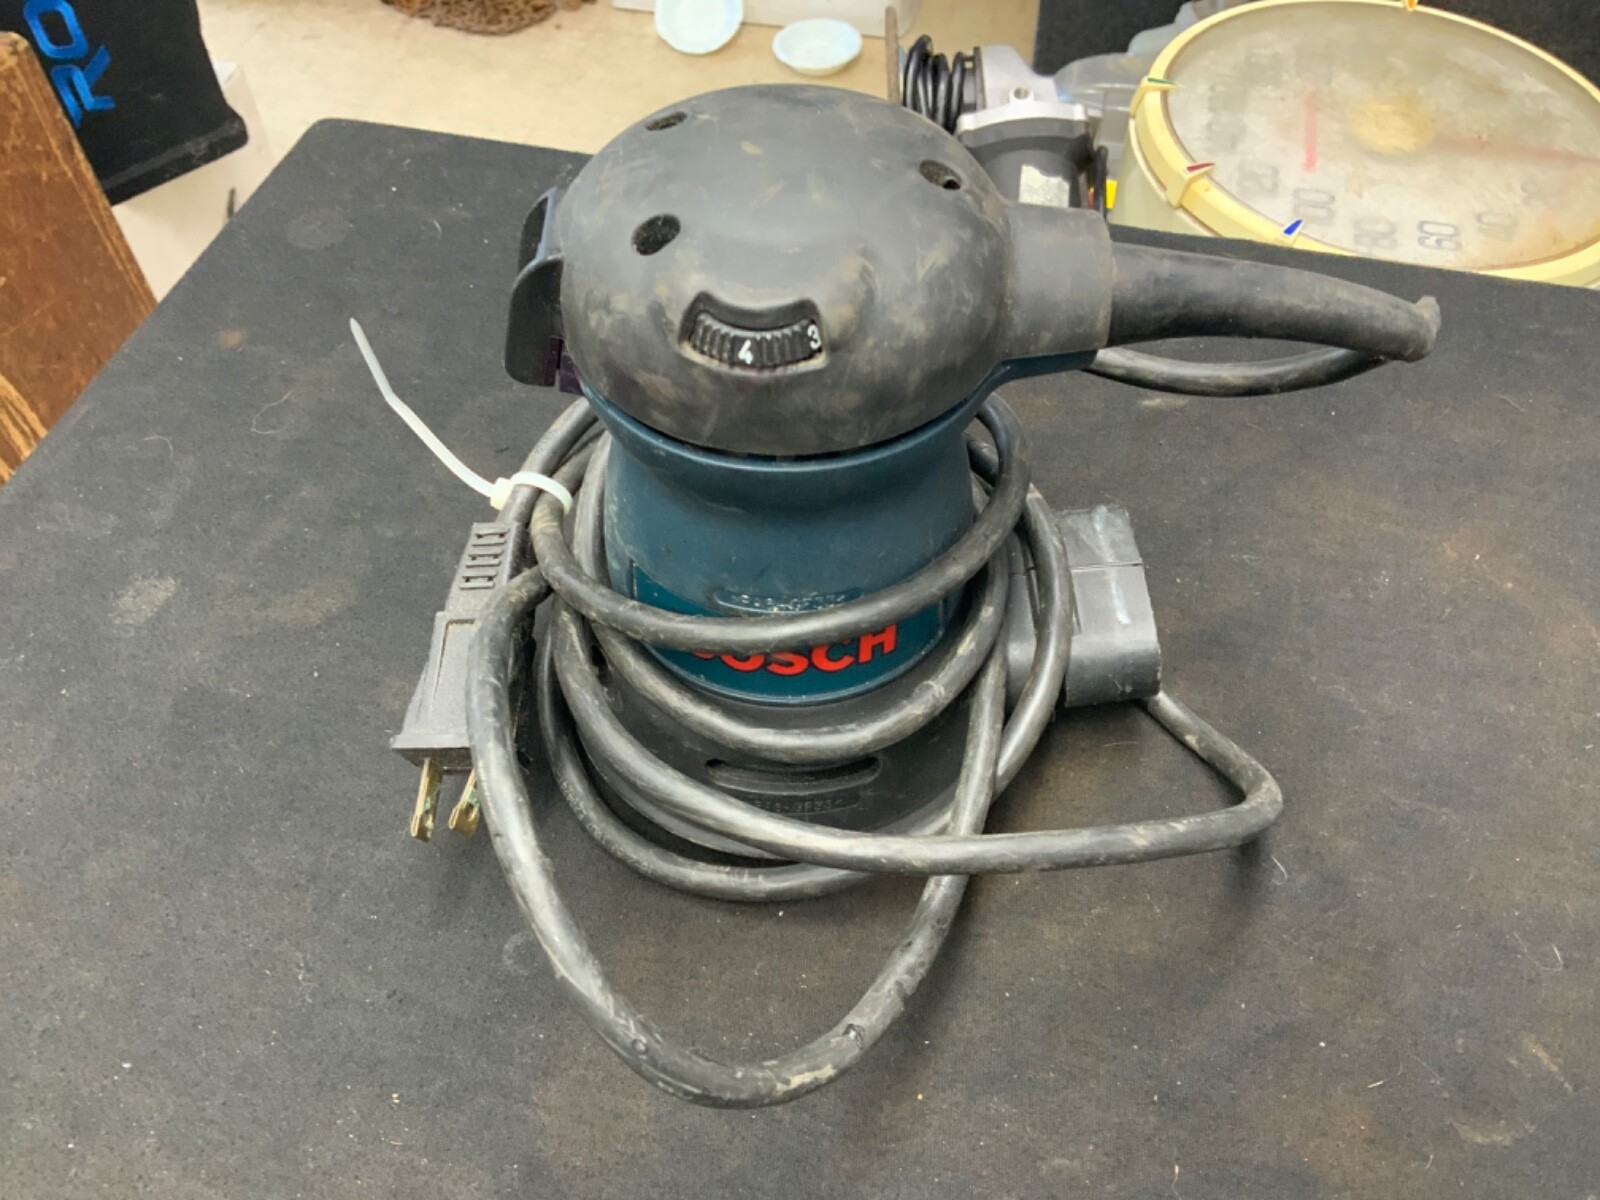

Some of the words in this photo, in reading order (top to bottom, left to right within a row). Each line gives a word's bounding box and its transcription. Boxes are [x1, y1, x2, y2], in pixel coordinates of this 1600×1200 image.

[1416, 219, 1463, 252] 60
[807, 323, 822, 351] 3
[738, 338, 754, 365] 4
